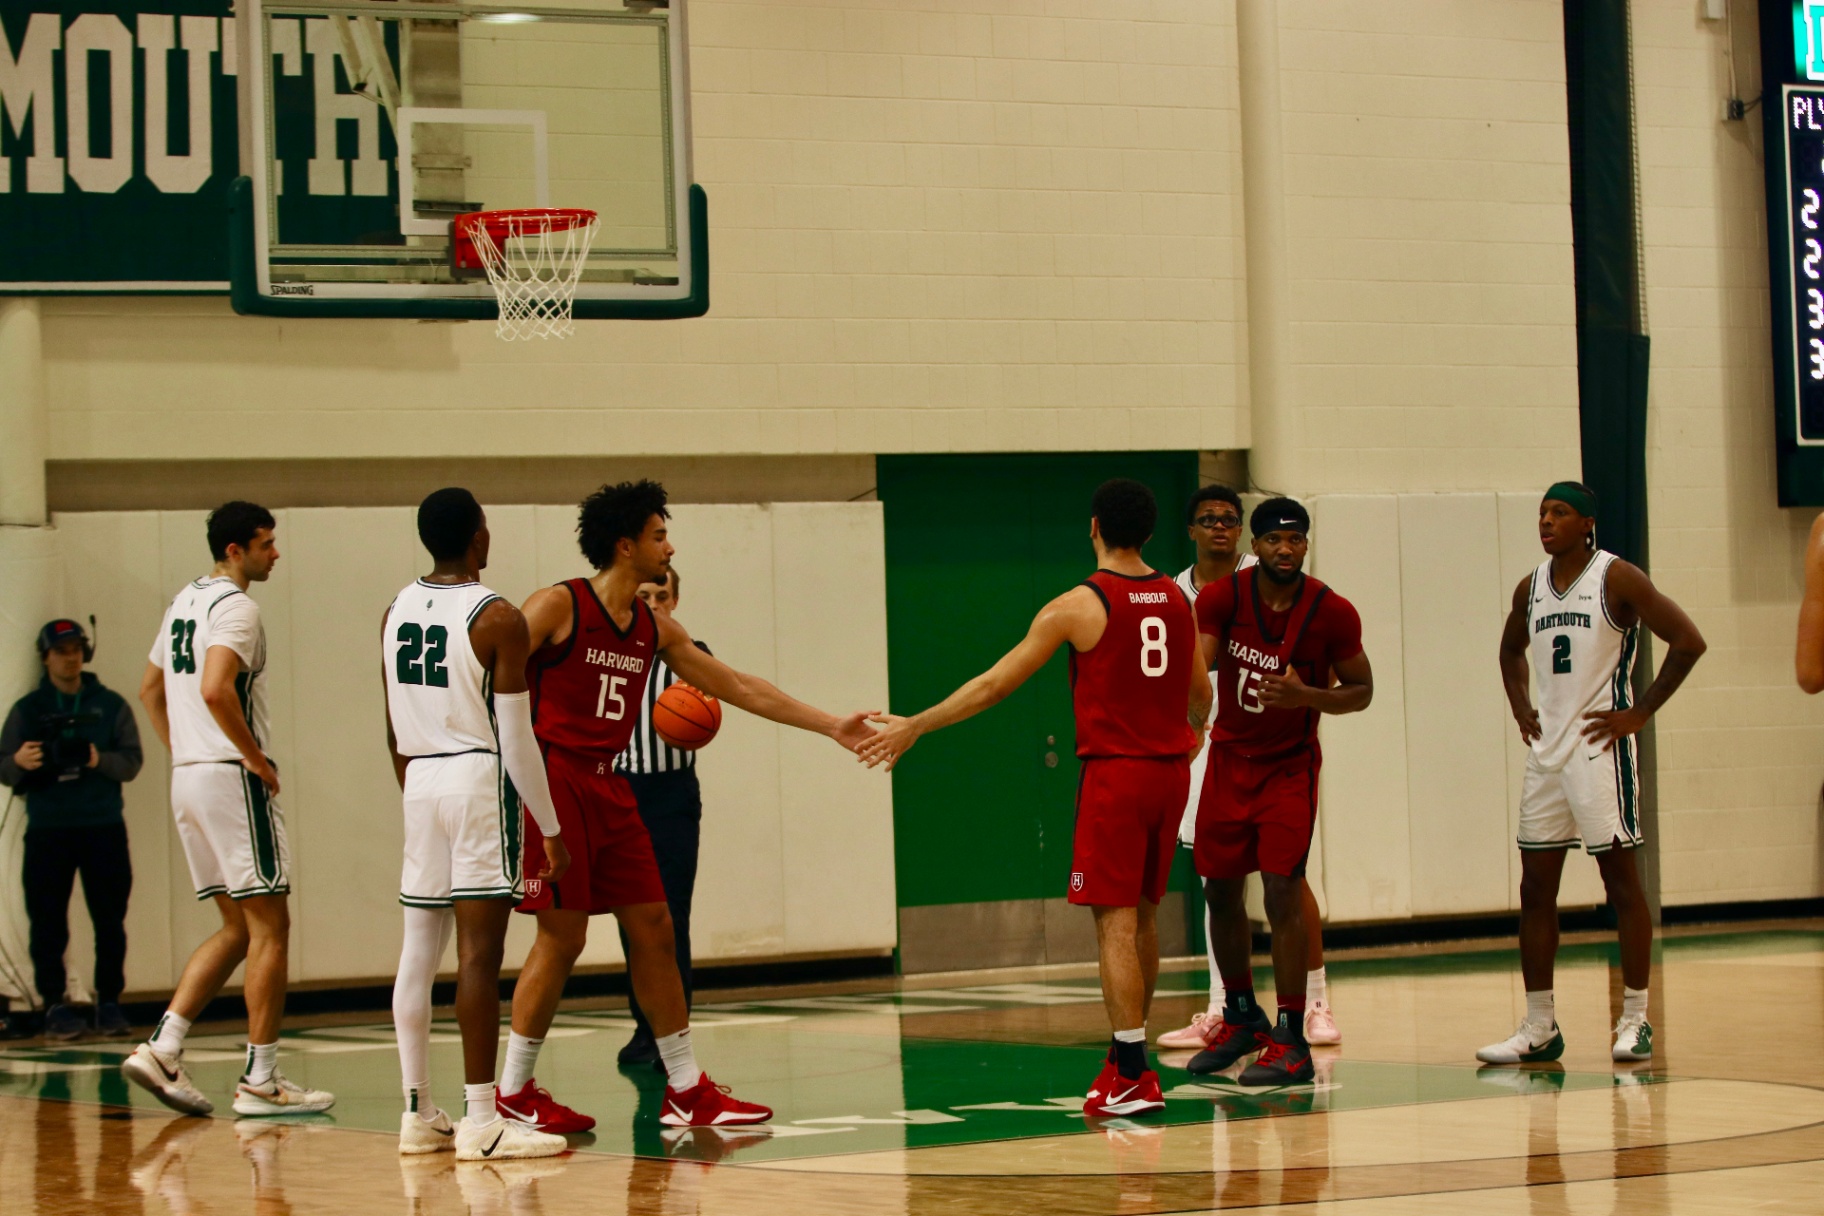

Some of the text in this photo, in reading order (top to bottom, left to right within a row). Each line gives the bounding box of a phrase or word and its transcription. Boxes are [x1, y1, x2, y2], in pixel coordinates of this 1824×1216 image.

[270, 285, 314, 295] SPALDING
[1128, 592, 1168, 604] BARBOUR
[1535, 612, 1591, 634] DARTMOUTH
[171, 618, 197, 674] 33
[396, 622, 449, 688] 22
[585, 647, 644, 674] HARVARD
[1140, 616, 1168, 677] 8
[1228, 639, 1279, 671] HARVA
[1552, 634, 1571, 675] 2
[595, 673, 628, 721] 15
